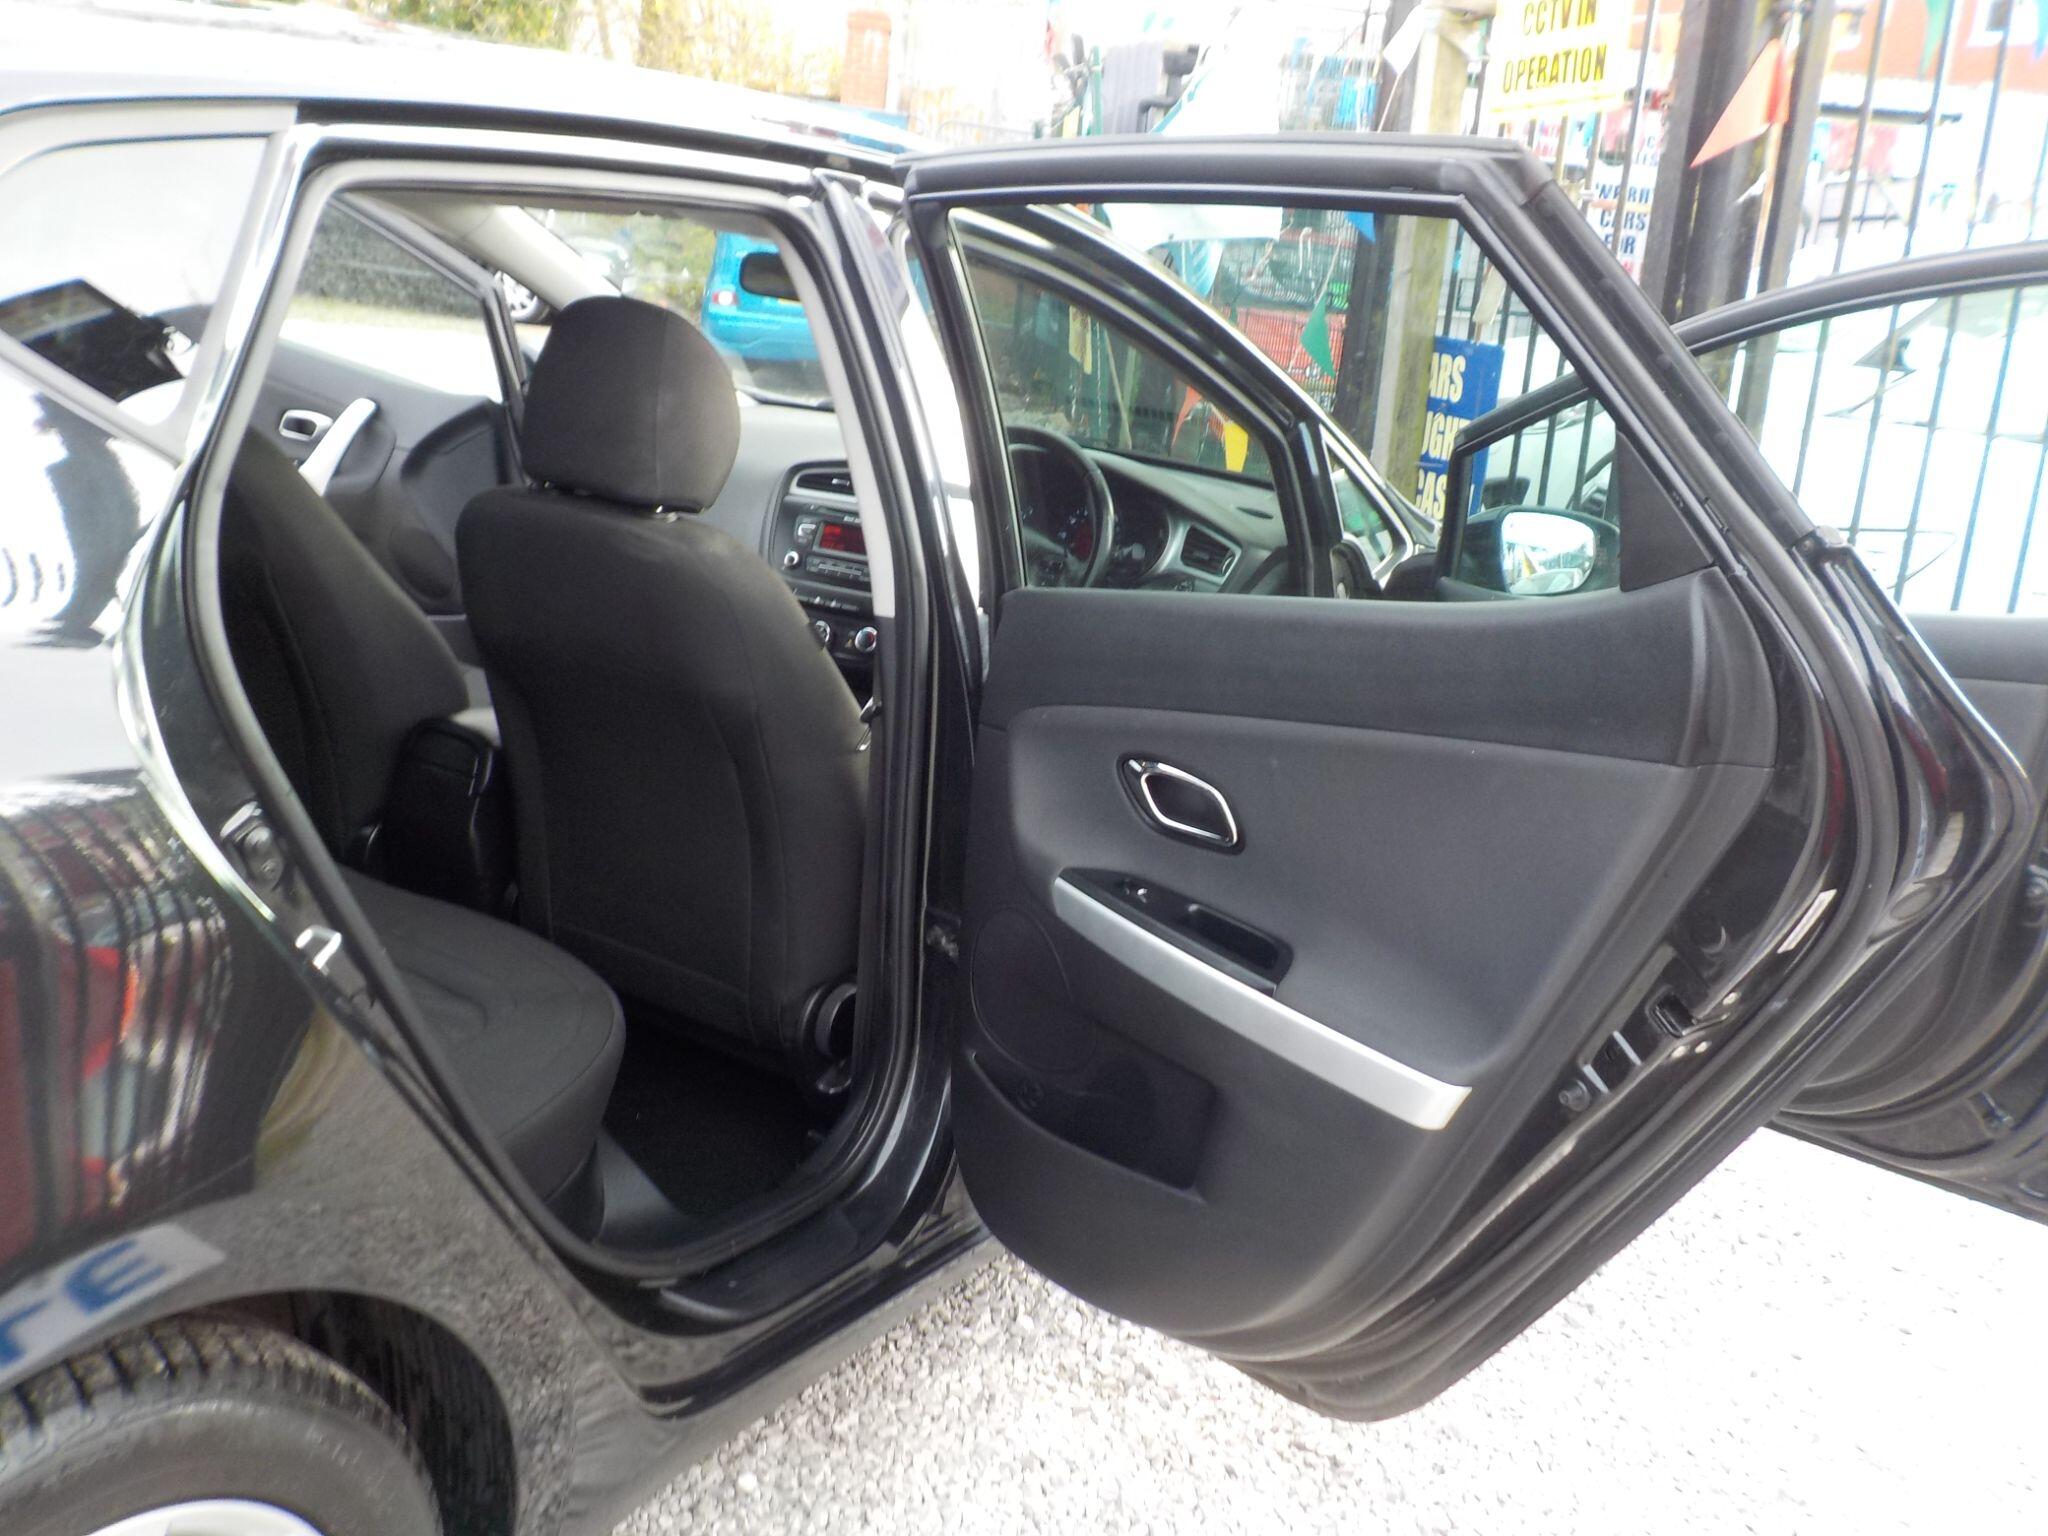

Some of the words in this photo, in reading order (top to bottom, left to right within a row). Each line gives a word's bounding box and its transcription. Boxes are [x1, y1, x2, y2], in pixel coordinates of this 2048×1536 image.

[1523, 0, 1572, 36] CCTV
[1577, 0, 1597, 26] IN
[1503, 43, 1607, 94] OPERATION
[1604, 233, 1636, 254] FR
[1429, 352, 1466, 403] ARS
